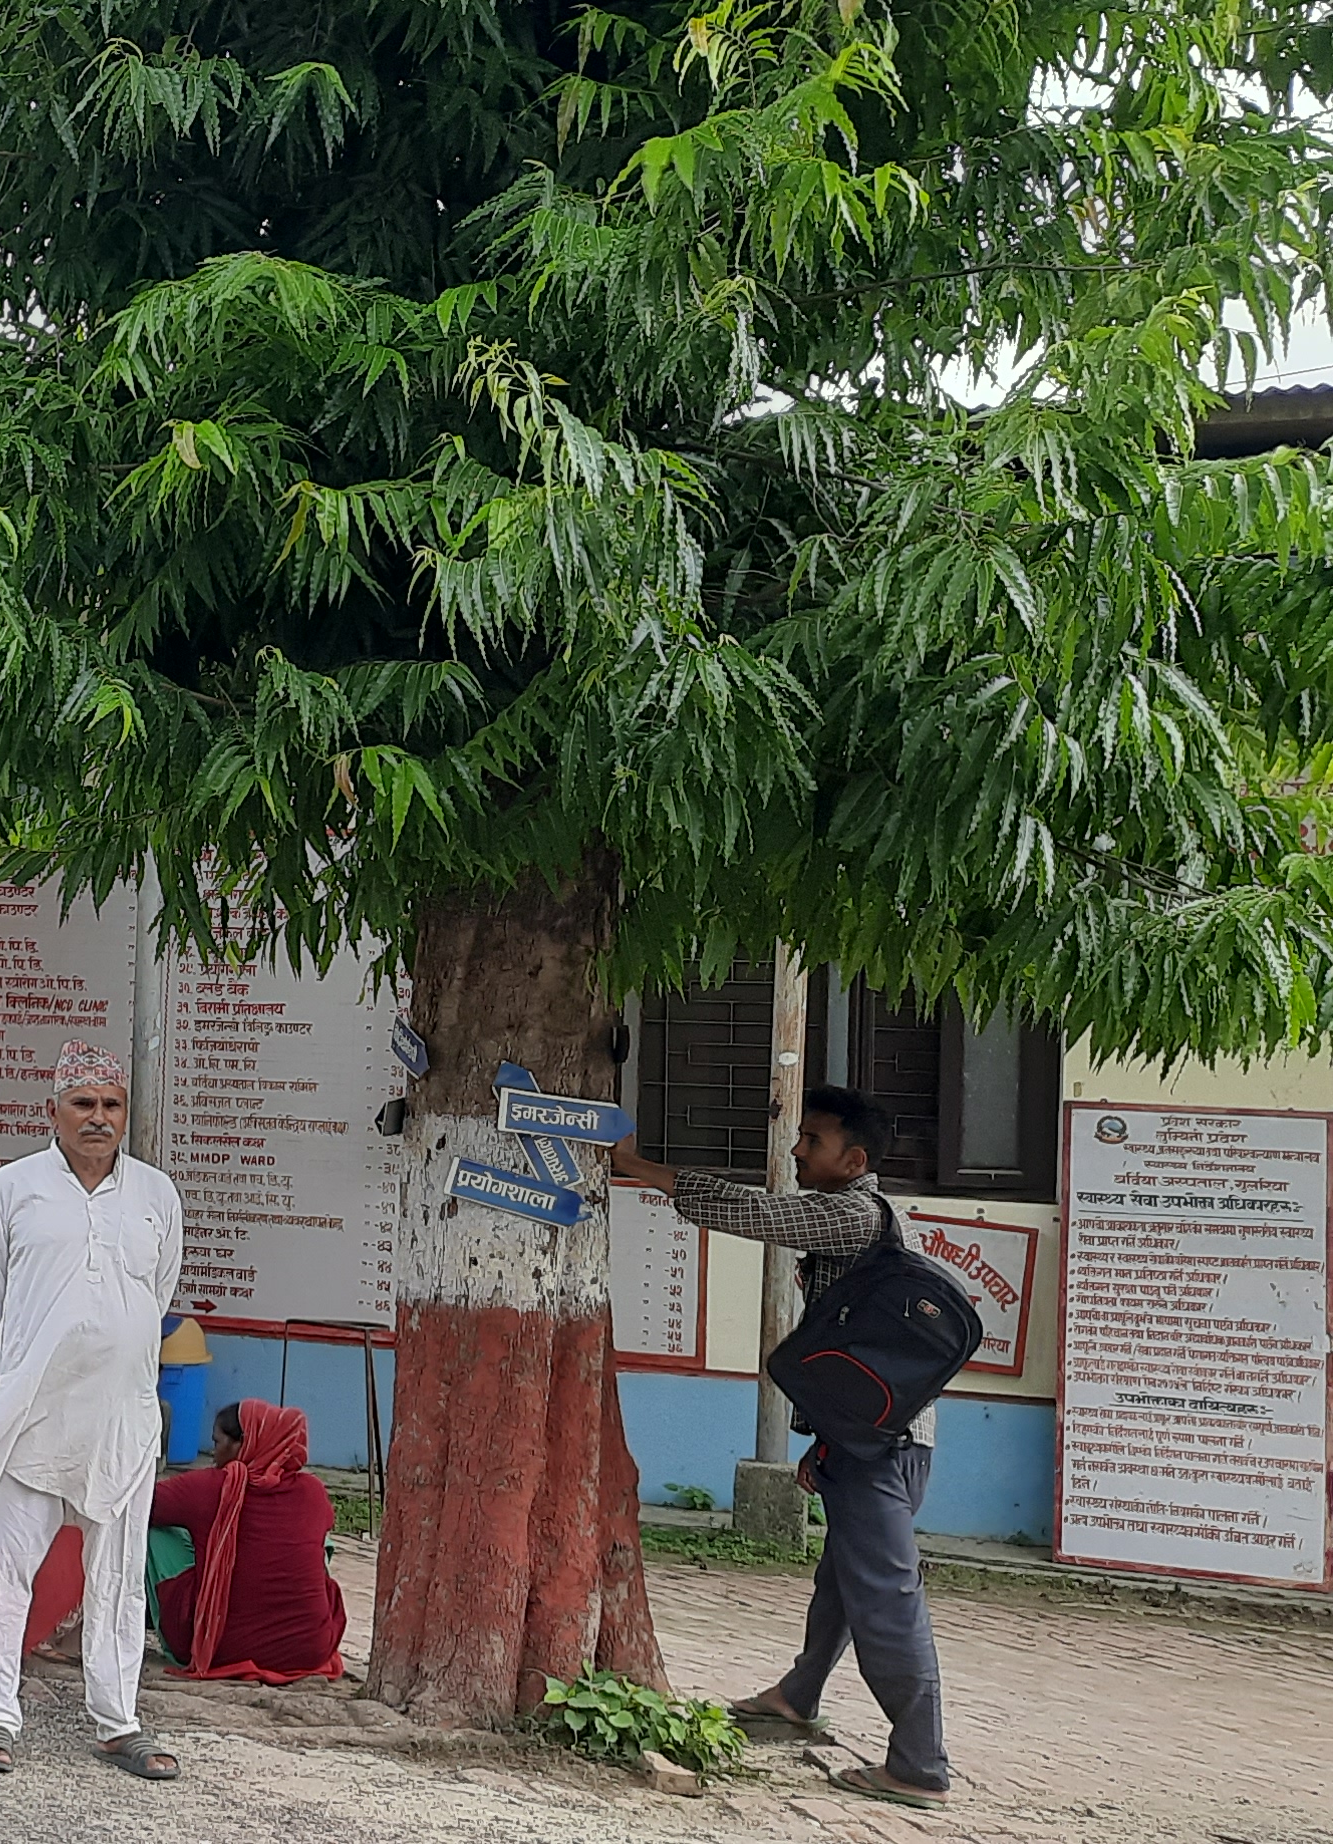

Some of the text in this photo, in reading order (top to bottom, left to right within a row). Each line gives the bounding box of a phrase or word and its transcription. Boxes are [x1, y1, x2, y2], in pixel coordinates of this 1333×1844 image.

[510, 1102, 600, 1131] इमरजेन्सी
[1196, 1117, 1242, 1129] सरकार
[190, 1153, 275, 1166] MMDP WARD
[534, 1136, 569, 1184] अस्पताल
[456, 1168, 557, 1211] प्रयोगशाला
[1114, 1172, 1158, 1187] बर्दिया
[1076, 1191, 1127, 1206] स्वास्थ्य
[1130, 1189, 1158, 1208] सेवा
[967, 1260, 1020, 1313] उपचार
